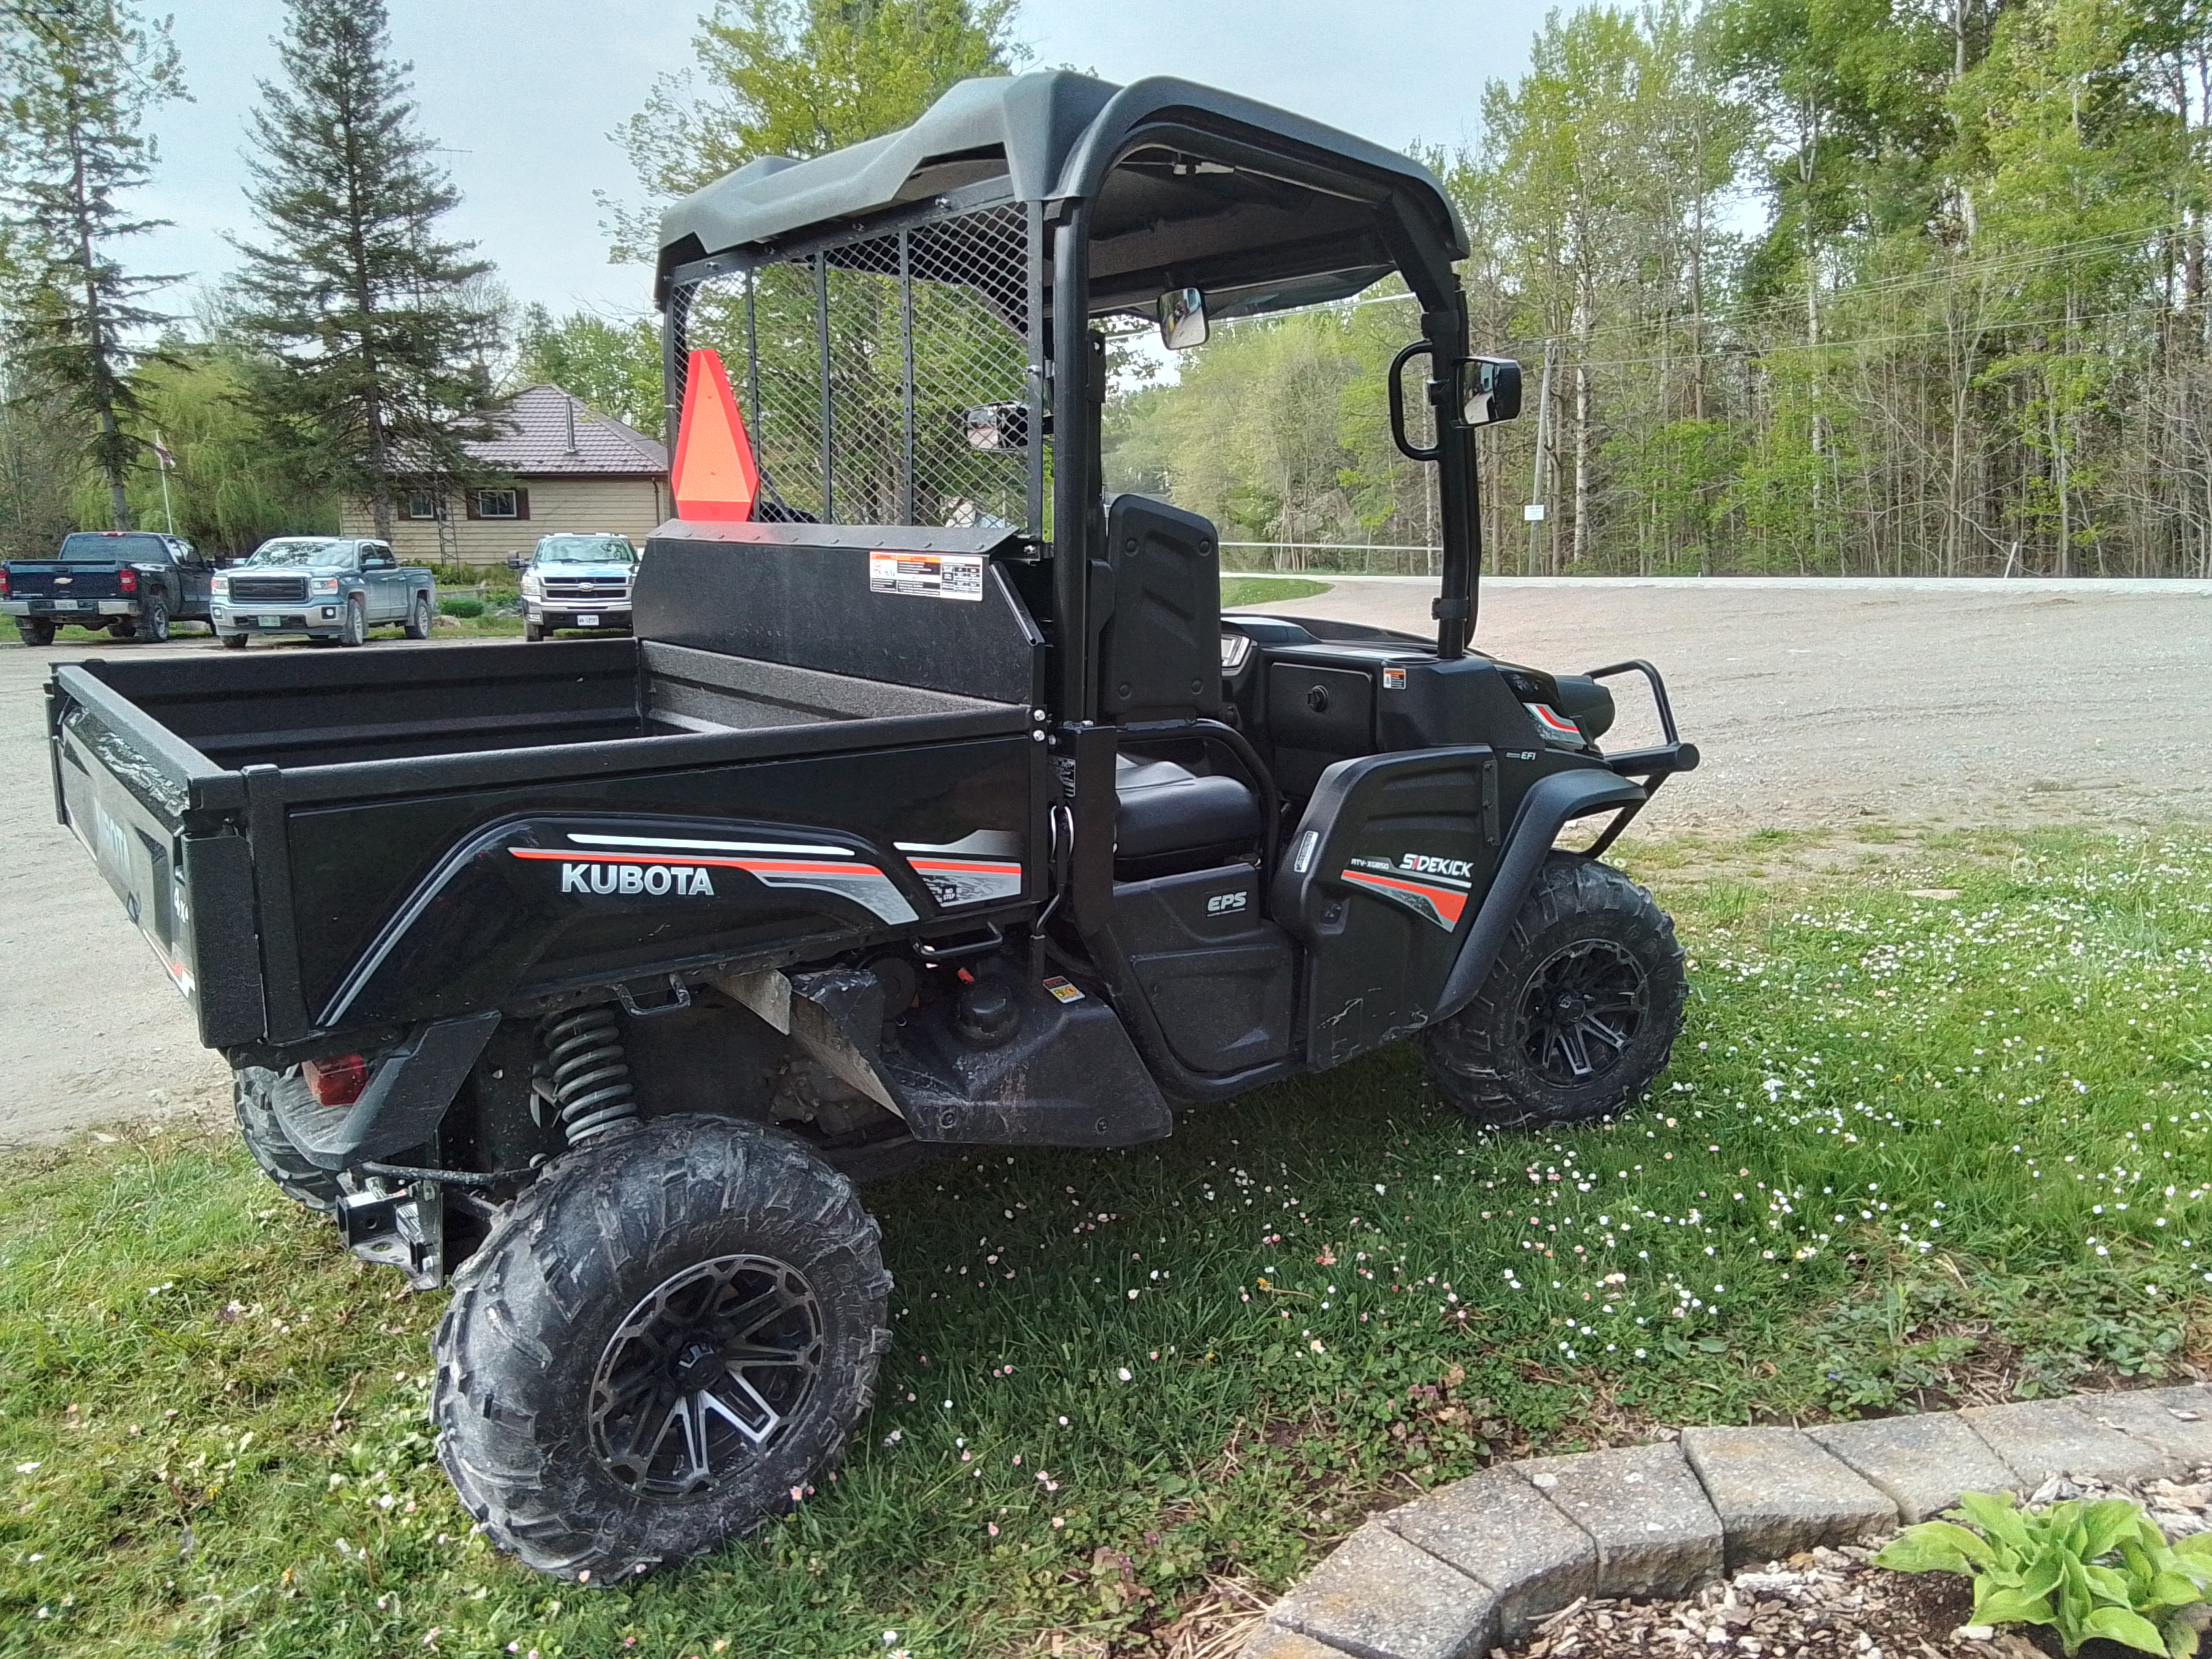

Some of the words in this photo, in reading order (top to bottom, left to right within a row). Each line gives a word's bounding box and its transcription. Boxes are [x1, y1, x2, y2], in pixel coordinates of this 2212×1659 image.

[1521, 752, 1536, 760] EFI
[1351, 858, 1389, 870] RTV-XG850
[562, 863, 714, 895] KUBOTA
[1208, 891, 1247, 912] EPS
